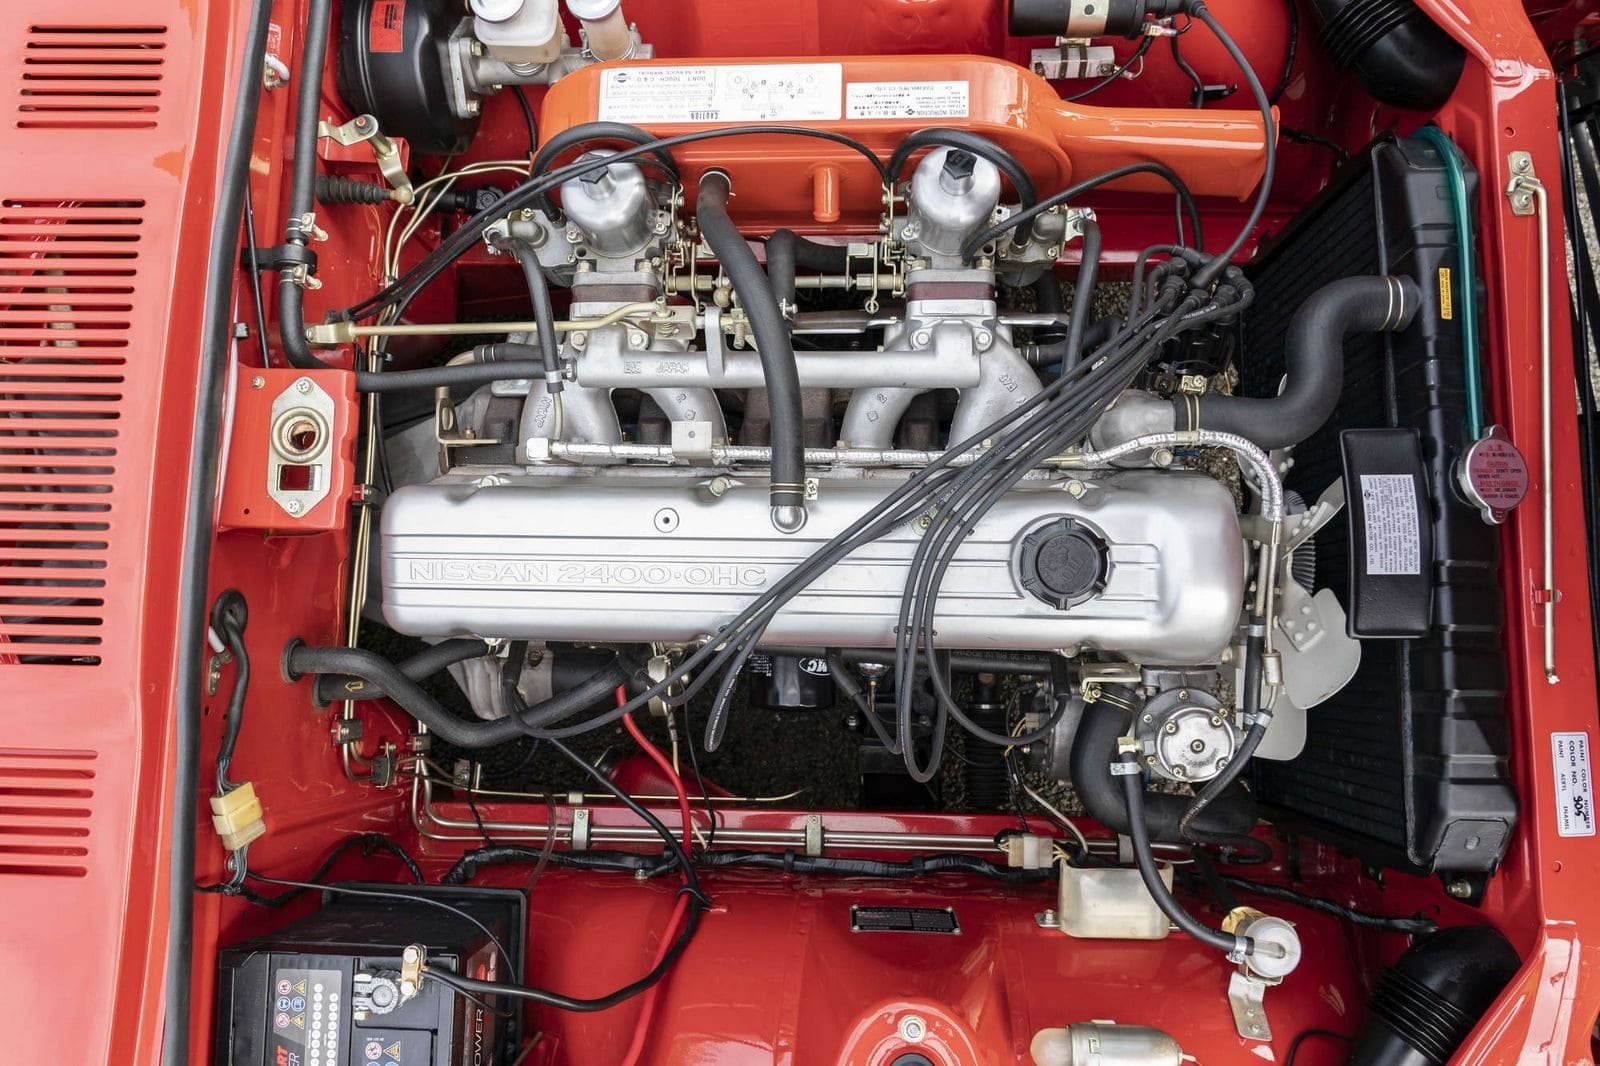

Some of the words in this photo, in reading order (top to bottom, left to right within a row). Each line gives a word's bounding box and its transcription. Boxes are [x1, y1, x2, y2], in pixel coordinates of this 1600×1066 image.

[690, 112, 719, 120] CAUTION
[656, 360, 689, 374] JAPAN
[534, 395, 552, 428] JAPAN
[409, 560, 548, 584] NISSAN
[1574, 796, 1586, 821] 905
[475, 1009, 484, 1066] OWER
